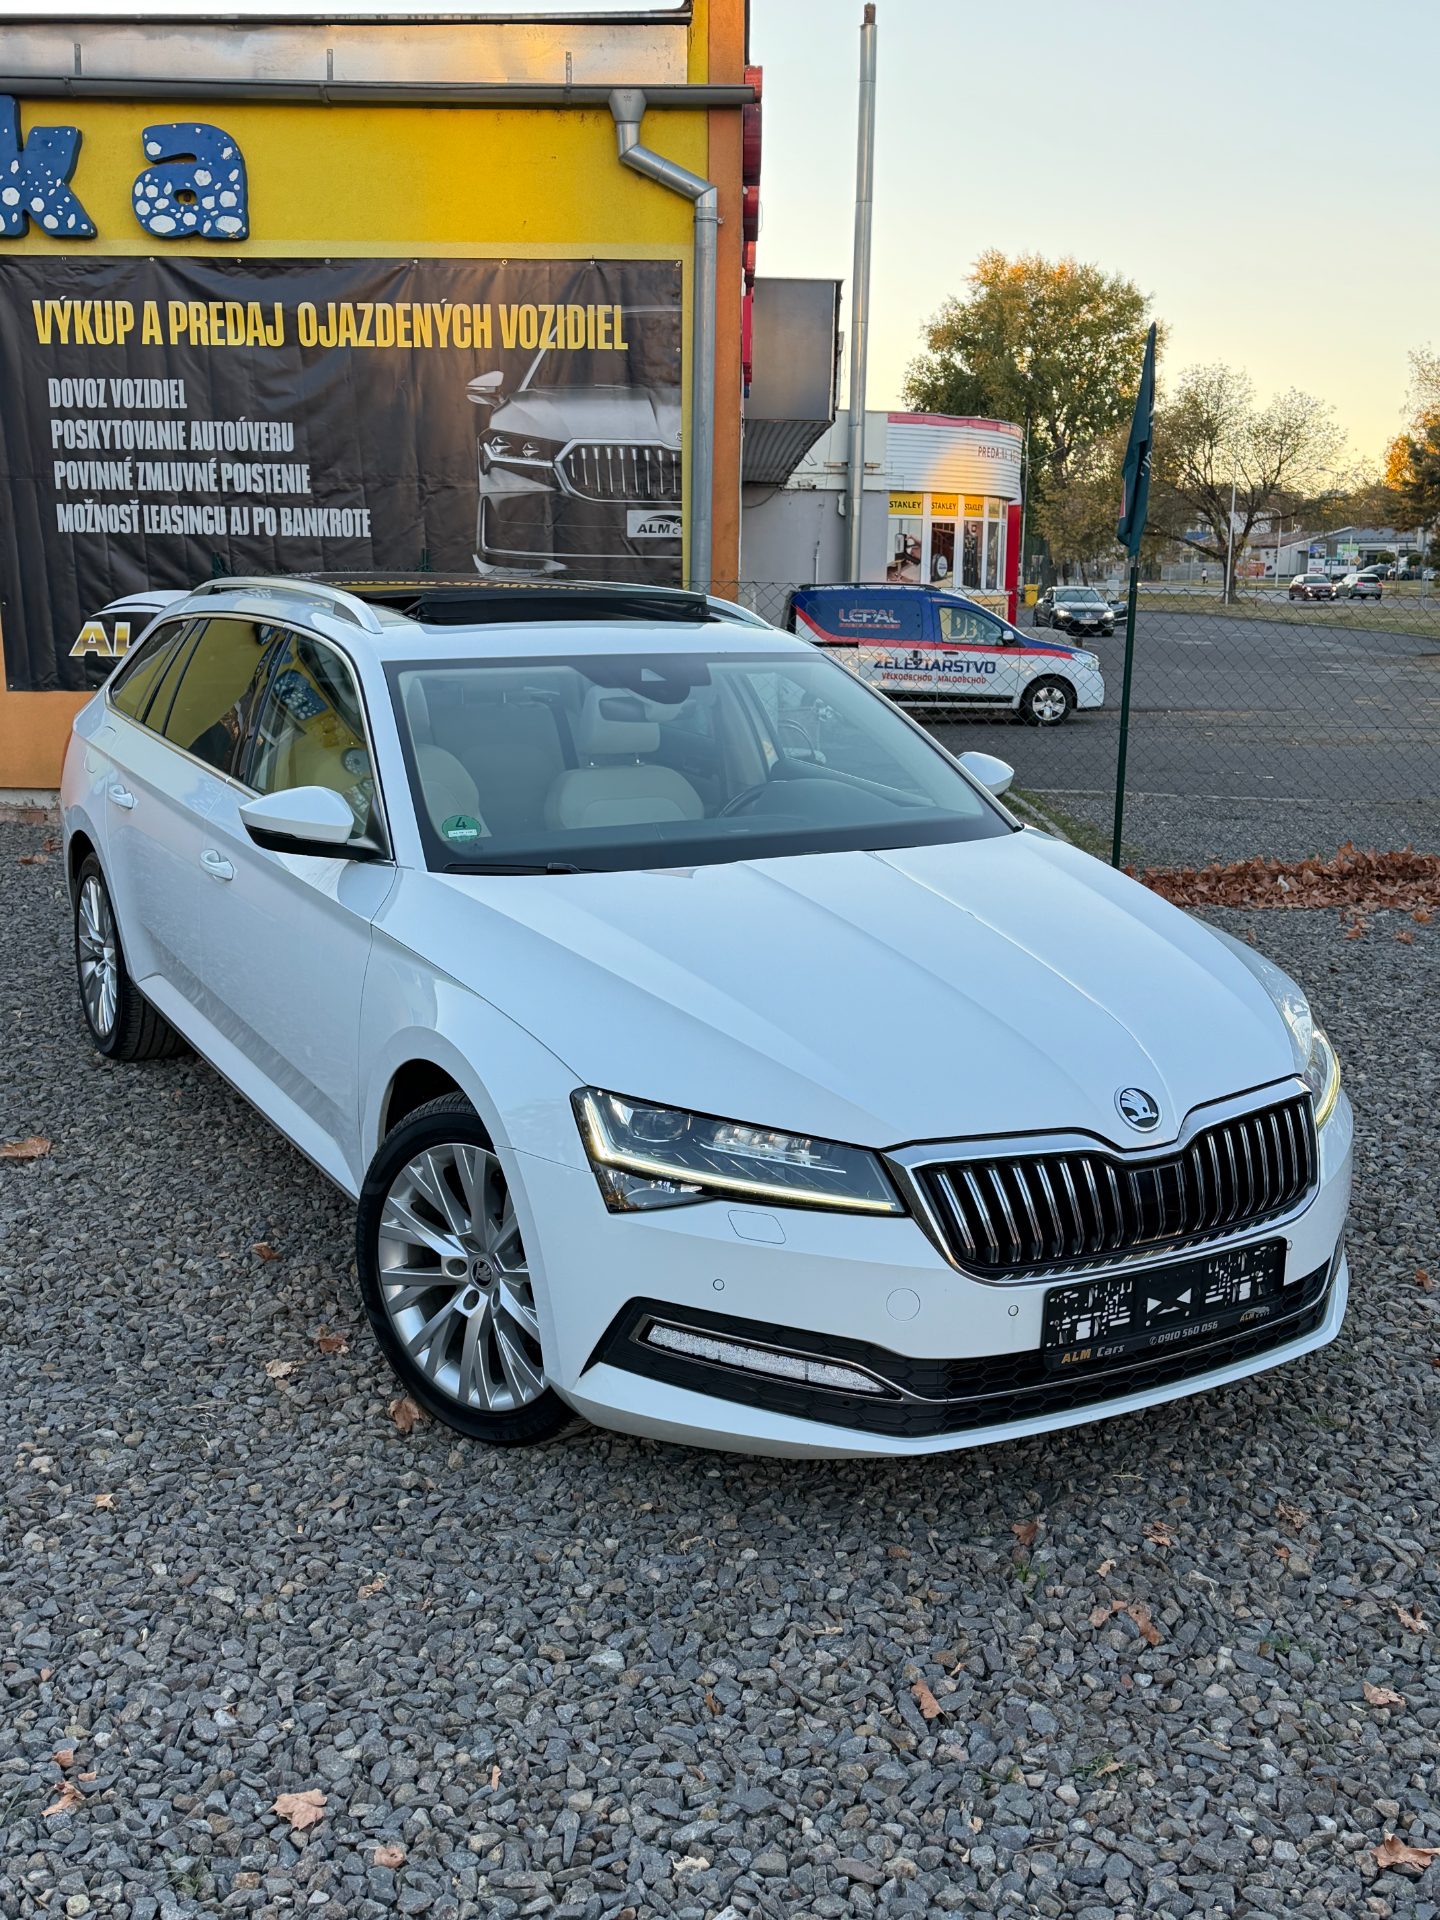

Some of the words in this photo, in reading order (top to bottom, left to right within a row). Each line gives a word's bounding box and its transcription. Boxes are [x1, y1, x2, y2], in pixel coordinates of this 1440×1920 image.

[32, 296, 134, 345] VÝKUP
[142, 300, 163, 345] A
[168, 301, 285, 346] PREDAJ
[297, 298, 492, 349] OJAZDENÝCH
[499, 303, 628, 350] VOZIDIEL
[48, 378, 107, 408] DOVOZ
[110, 378, 187, 409] VOZIDIEL
[50, 419, 186, 450] POSKYTOVANIE
[190, 416, 295, 452] AUTOÚVERU
[54, 456, 132, 491] POVINNÉ
[136, 457, 218, 492] ZMLUVNÉ
[221, 462, 311, 494] POISTENIE
[889, 500, 922, 509] STANLEY
[931, 501, 957, 510] STANLEY
[964, 503, 984, 512] STANLEY
[56, 498, 139, 533] MOŽNOSŤ
[144, 503, 226, 535] LEASINGU
[230, 506, 249, 535] AJ
[253, 506, 276, 536] PO
[280, 507, 371, 538] BANKROTE
[636, 523, 671, 534] ALM
[838, 608, 901, 623] LEPAL
[455, 816, 468, 829] 4
[1157, 1330, 1181, 1343] 0910
[1182, 1325, 1200, 1338] 560
[1201, 1320, 1219, 1333] 056
[1061, 1347, 1092, 1364] ALM
[1096, 1344, 1126, 1357] Cars
